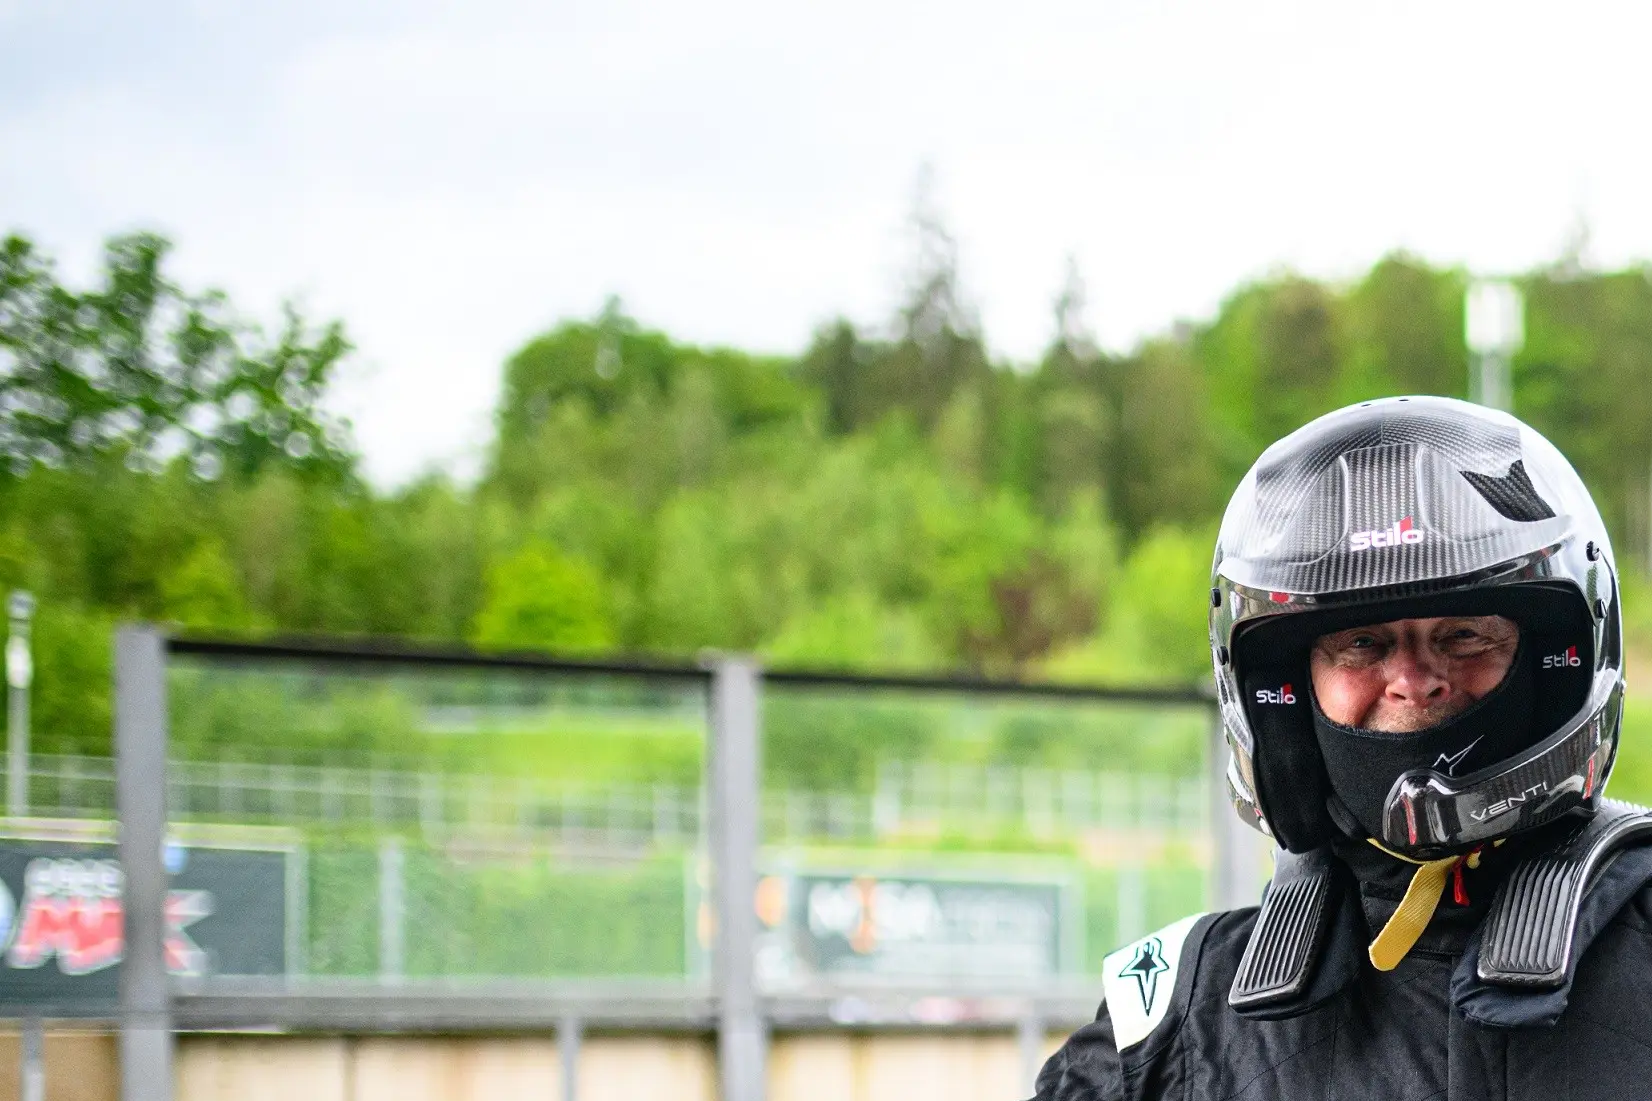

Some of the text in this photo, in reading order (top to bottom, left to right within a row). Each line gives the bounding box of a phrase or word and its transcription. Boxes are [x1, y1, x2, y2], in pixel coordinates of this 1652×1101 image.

[1350, 517, 1424, 552] Stilo
[1543, 647, 1581, 669] Stilo
[1256, 685, 1297, 704] Stilo
[1469, 781, 1548, 821] VENTI
